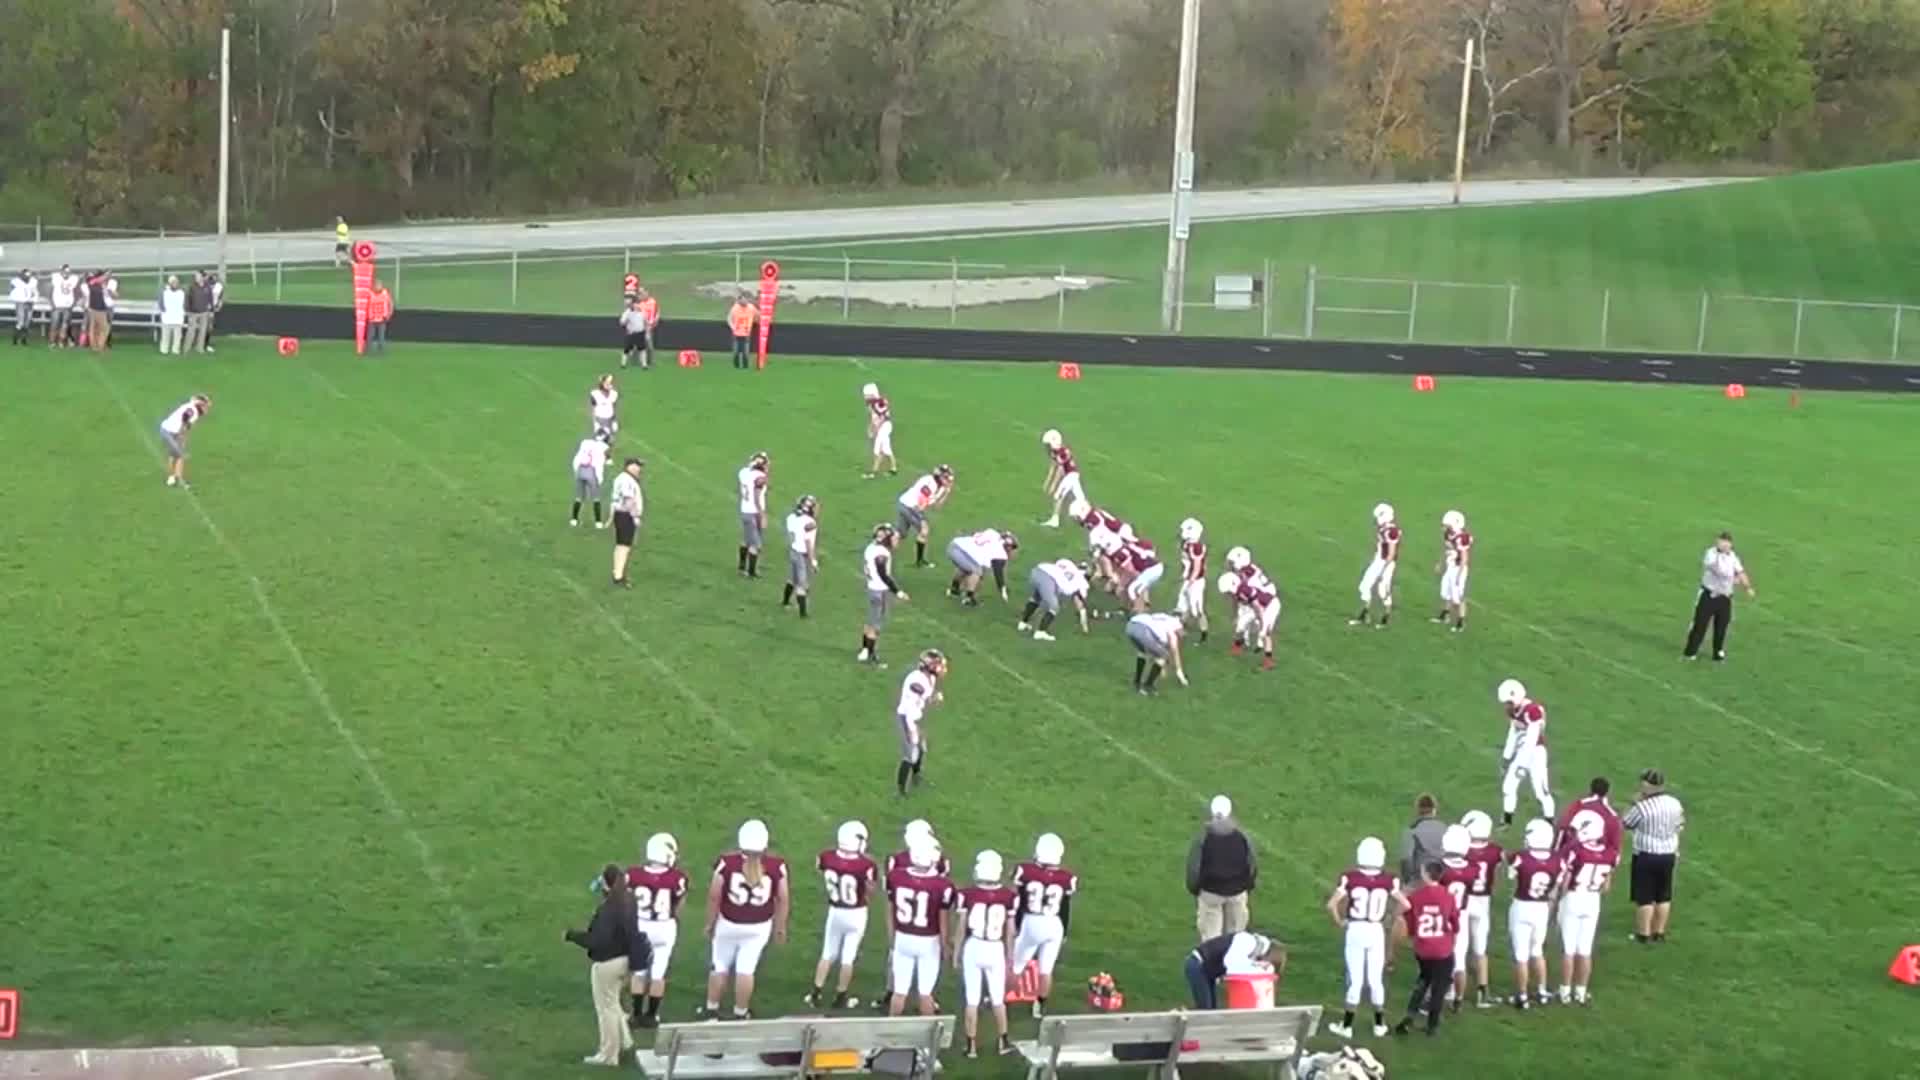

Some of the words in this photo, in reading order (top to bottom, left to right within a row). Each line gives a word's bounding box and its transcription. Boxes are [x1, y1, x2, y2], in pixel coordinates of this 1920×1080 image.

[727, 872, 772, 907] 59
[895, 886, 928, 928] 51
[1348, 887, 1388, 922] 30
[1417, 913, 1444, 938] 21
